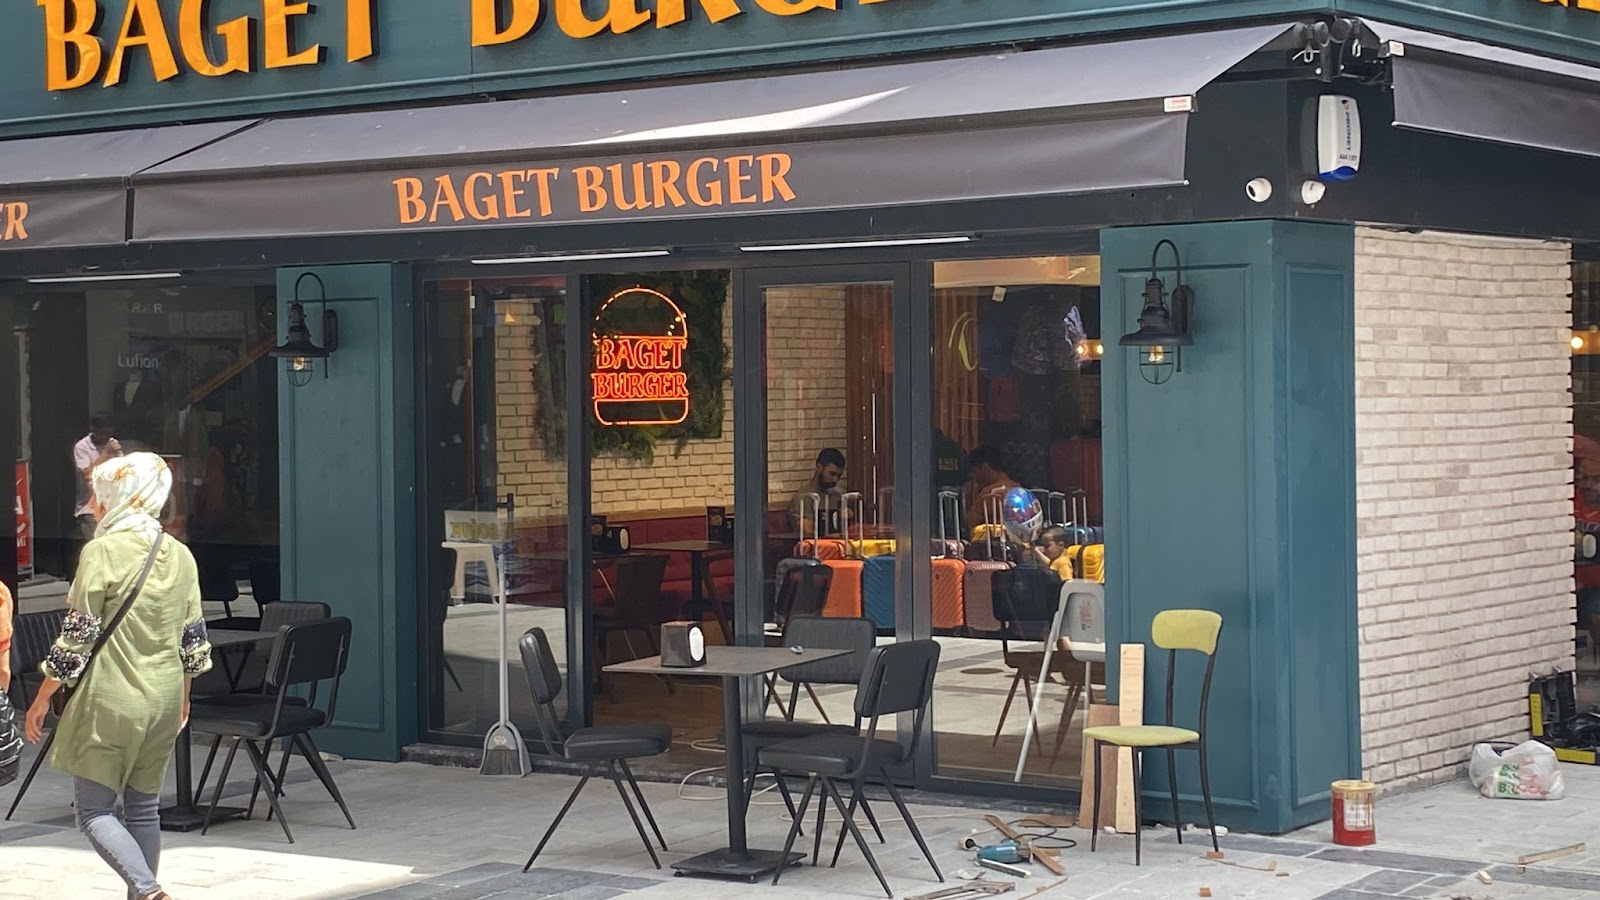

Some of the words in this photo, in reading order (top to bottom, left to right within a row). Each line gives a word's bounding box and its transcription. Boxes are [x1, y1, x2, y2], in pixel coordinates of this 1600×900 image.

[392, 167, 560, 224] BAGET
[571, 152, 797, 213] BURGER
[0, 202, 28, 240] R
[593, 339, 688, 369] BAGET
[591, 372, 689, 399] BURGER
